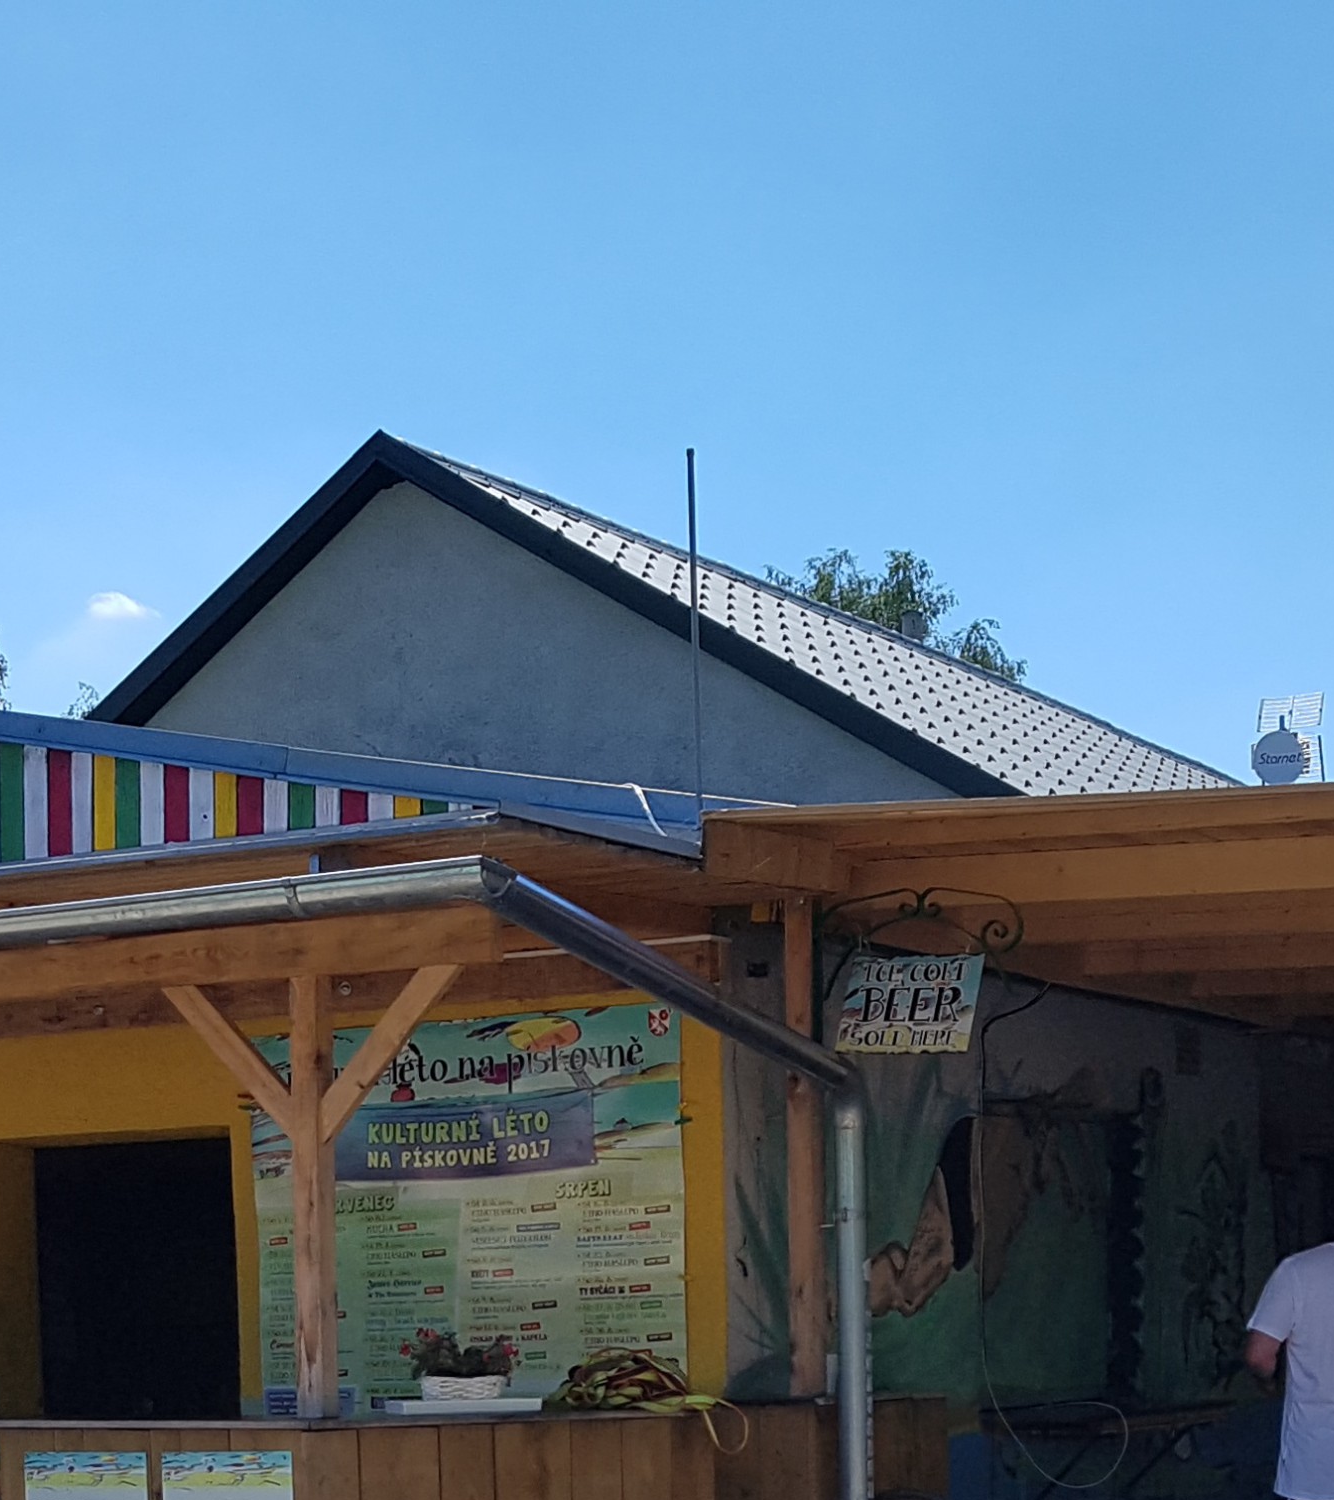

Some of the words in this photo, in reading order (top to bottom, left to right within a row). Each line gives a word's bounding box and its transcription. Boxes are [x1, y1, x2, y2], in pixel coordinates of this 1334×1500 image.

[864, 961, 901, 983] ICE
[910, 959, 971, 983] COLD
[855, 985, 963, 1024] BEER
[849, 1028, 906, 1047] SOLD
[910, 1029, 959, 1047] HERE
[391, 1045, 448, 1086] léto
[457, 1055, 496, 1081] na
[366, 1113, 482, 1146] KULTURNÍ
[491, 1108, 551, 1138] LÉTO
[366, 1150, 393, 1170] NA
[400, 1141, 498, 1170] PÍSKOVNĚ
[506, 1137, 552, 1163] 2017
[554, 1178, 612, 1200] SRPEN
